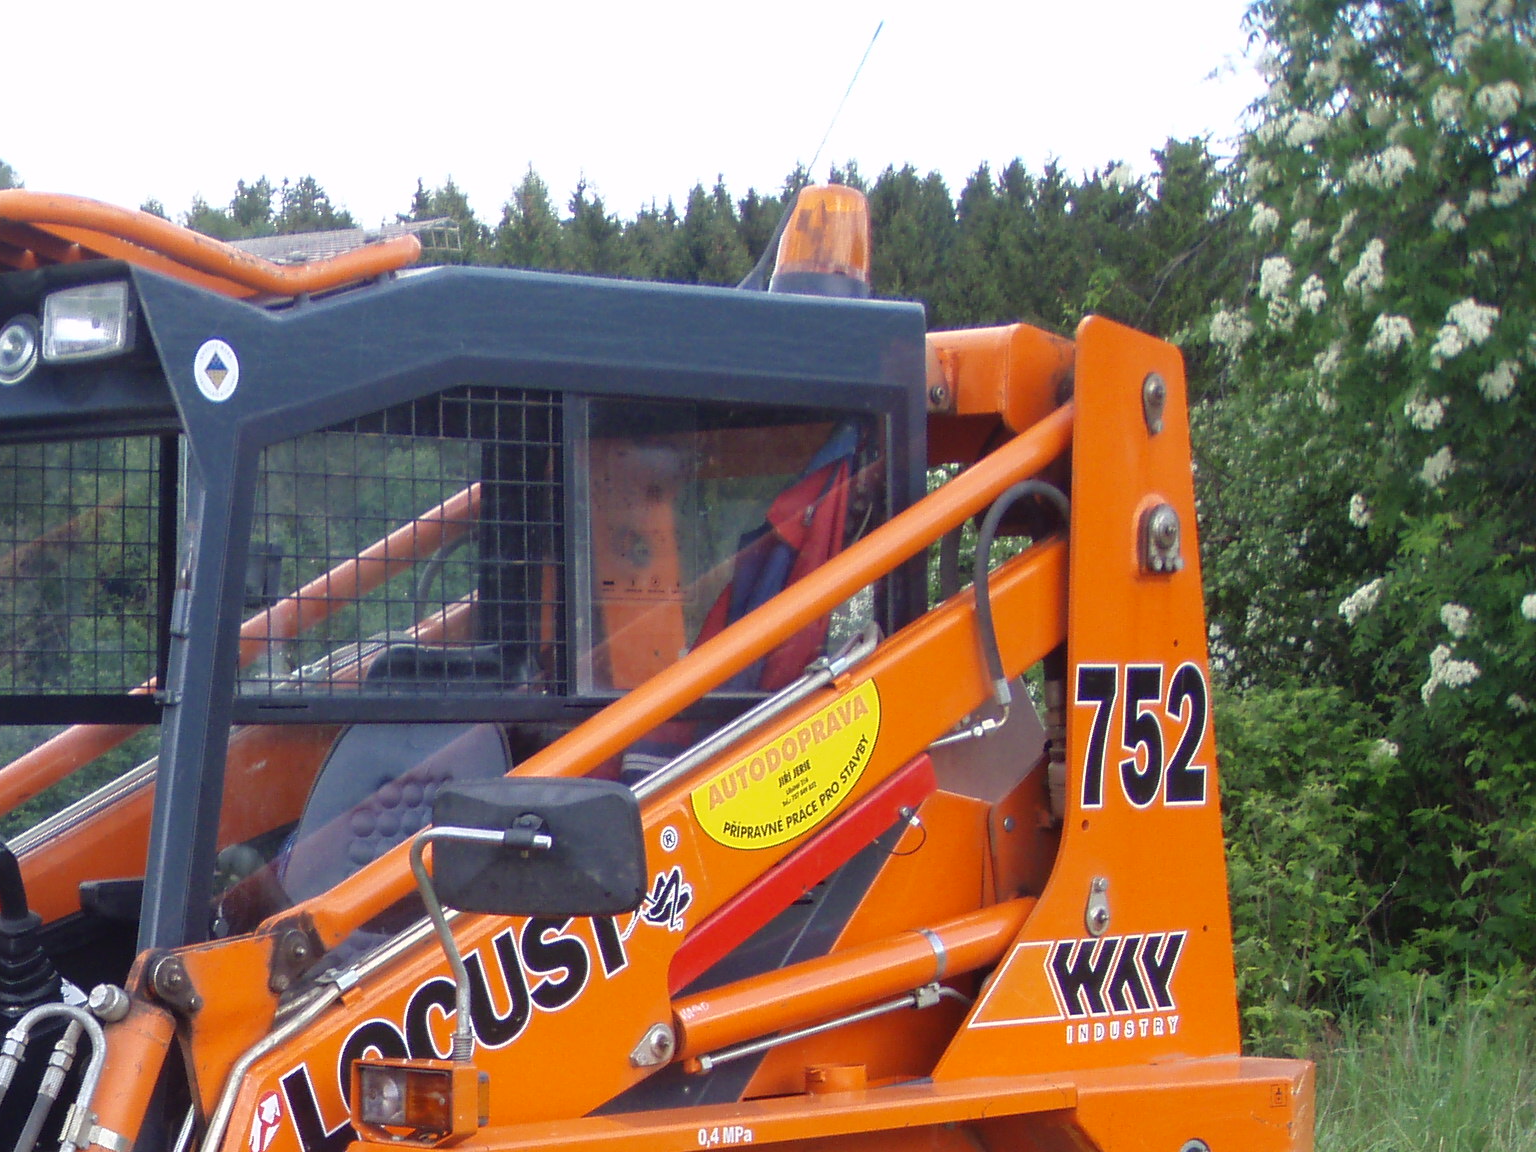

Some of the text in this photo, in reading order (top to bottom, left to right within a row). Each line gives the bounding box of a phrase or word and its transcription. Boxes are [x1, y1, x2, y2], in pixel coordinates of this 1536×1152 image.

[708, 694, 869, 811] AUTODOPRAVA
[723, 815, 784, 839] PŘÍPRAVNÉ
[786, 800, 818, 832] PRÁCE
[819, 781, 840, 807] PRO
[839, 733, 870, 785] STAVBY
[1075, 661, 1208, 808] 752
[1066, 1015, 1181, 1044] INDUSTRY
[697, 1126, 753, 1147] 0,4 MPa
